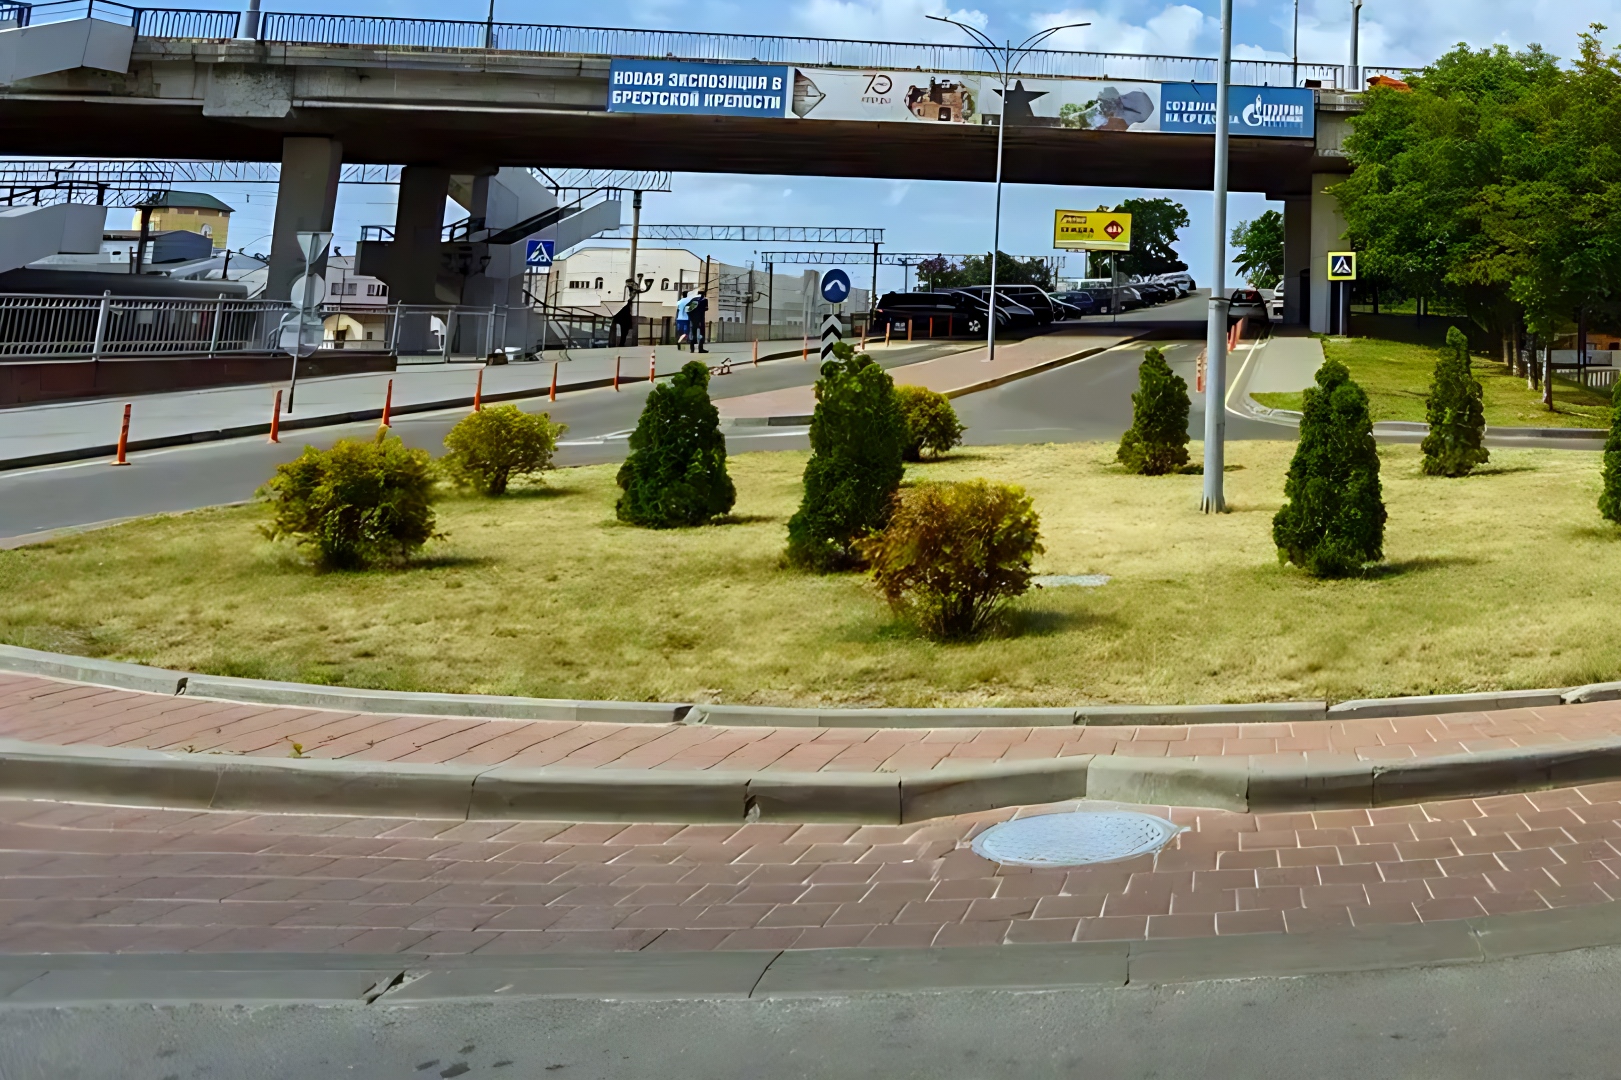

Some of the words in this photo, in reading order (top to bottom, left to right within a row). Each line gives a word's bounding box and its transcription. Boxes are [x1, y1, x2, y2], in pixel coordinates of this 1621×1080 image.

[614, 71, 663, 86] НОВАЯ
[668, 73, 767, 90] ЭКСПОЗИЦИЯ
[771, 77, 782, 90] В
[612, 90, 699, 107] БРЕСТСКОЙ
[704, 93, 781, 109] КРЕПОСТИ
